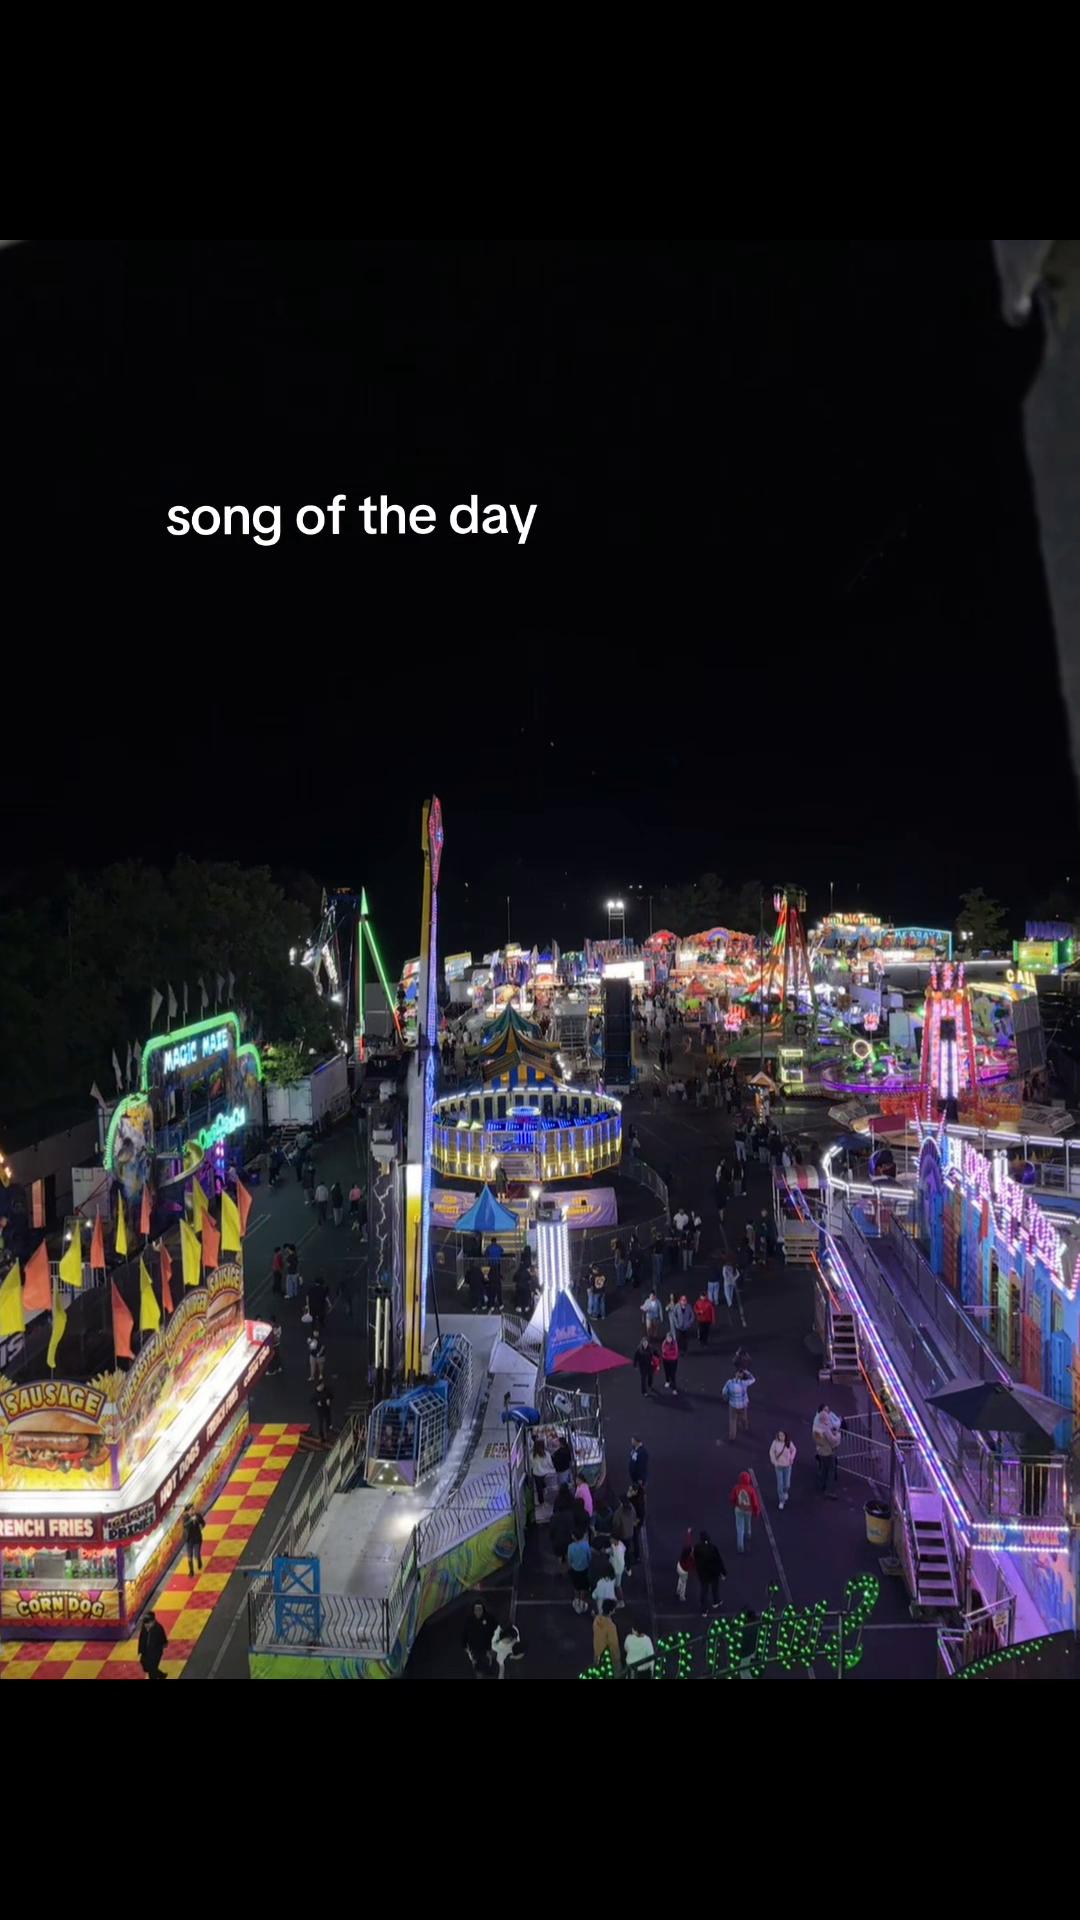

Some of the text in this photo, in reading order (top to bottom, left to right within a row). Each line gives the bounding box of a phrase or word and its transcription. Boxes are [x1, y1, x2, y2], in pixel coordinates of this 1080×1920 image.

[163, 1027, 229, 1075] MAGIC MAZE
[5, 1384, 101, 1417] SAUSAGE
[160, 1440, 200, 1507] HOT DOGS
[48, 1518, 94, 1537] FRIES
[978, 1528, 1060, 1546] NEW YORK
[18, 1597, 104, 1617] CORN DOG
